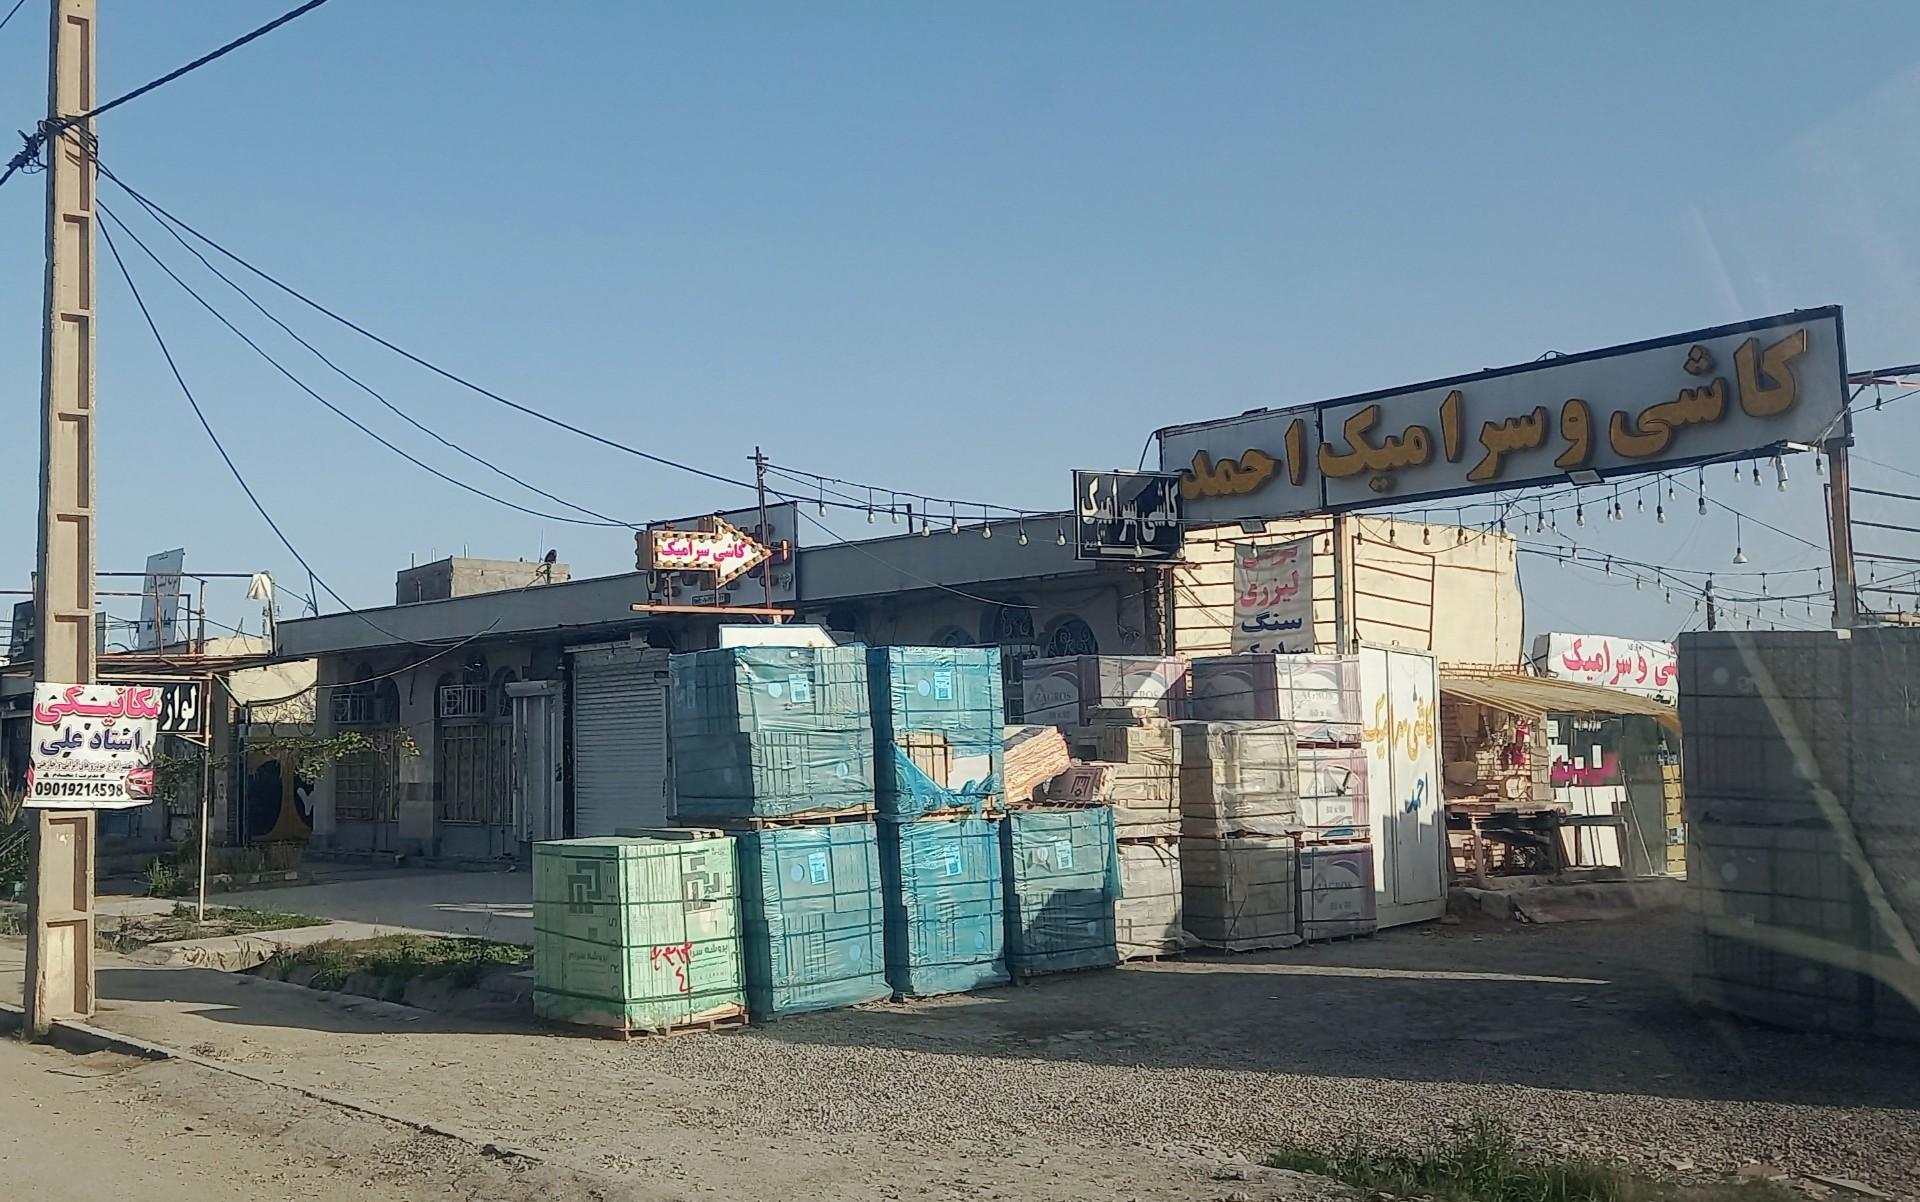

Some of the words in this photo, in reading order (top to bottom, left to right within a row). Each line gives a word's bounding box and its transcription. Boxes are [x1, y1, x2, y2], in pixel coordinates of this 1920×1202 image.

[1609, 328, 1808, 458] کاشی
[1317, 389, 1547, 494] سرامیک
[1554, 398, 1590, 468] و
[1181, 418, 1304, 500] احمد
[1081, 476, 1138, 542] سرامیک
[1141, 479, 1179, 543] کاشی
[661, 538, 710, 562] سرامیک
[713, 541, 747, 562] کاشی
[1562, 638, 1633, 686] سرامیک
[1635, 654, 1648, 685] و
[34, 684, 162, 726] مکانیکی
[161, 685, 197, 731] لواز
[40, 727, 84, 756] علی
[35, 781, 125, 797] 09019214598
